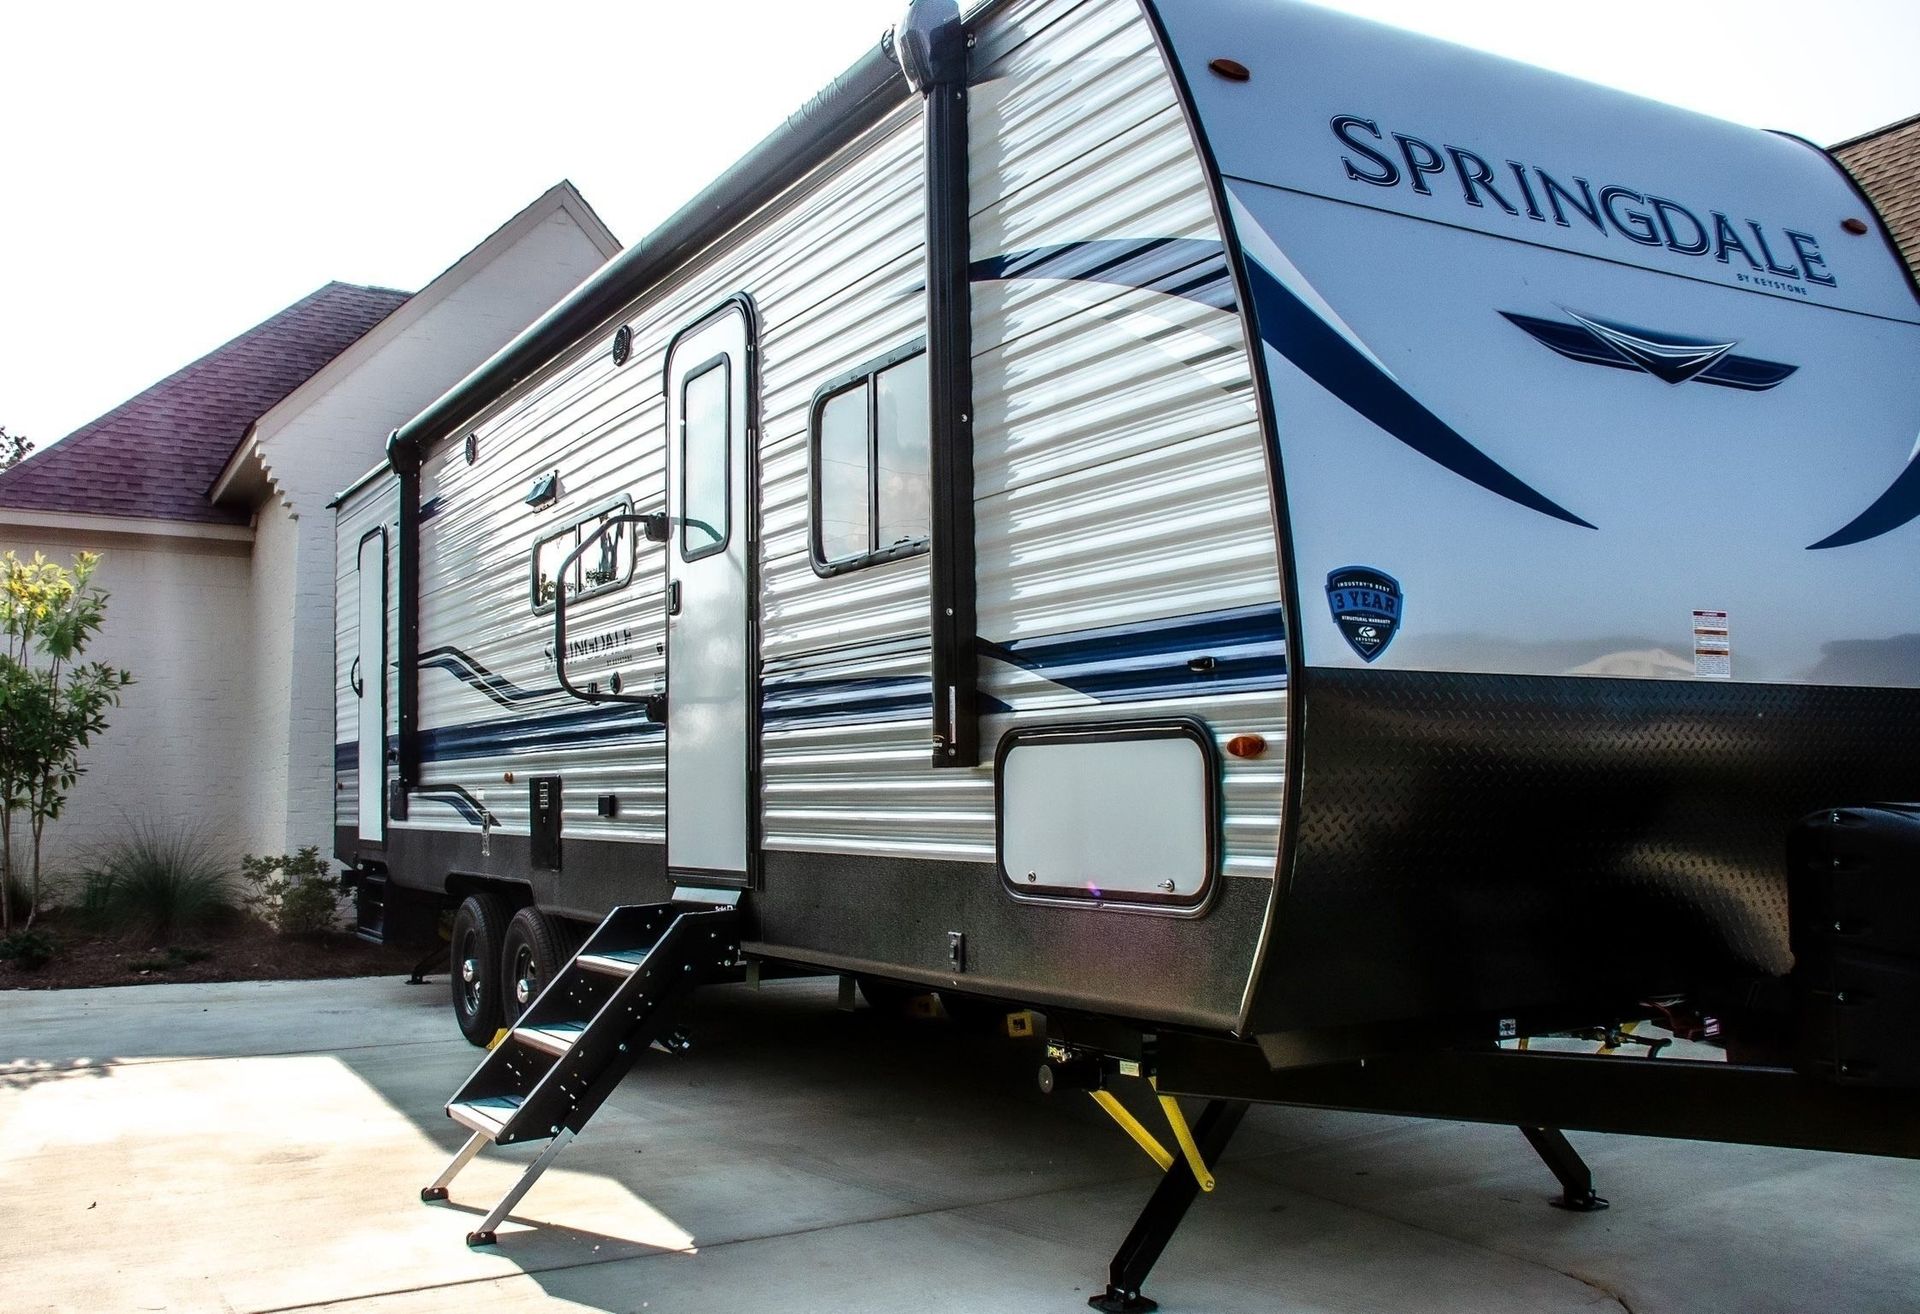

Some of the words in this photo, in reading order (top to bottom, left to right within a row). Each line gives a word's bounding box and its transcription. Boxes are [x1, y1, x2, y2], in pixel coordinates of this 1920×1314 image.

[1329, 114, 1837, 287] SPRINGDALE
[1737, 273, 1749, 283] BY
[1753, 277, 1807, 295] KEYSTONE
[1334, 593, 1345, 610] 3
[1349, 590, 1395, 614] YEAR
[1341, 615, 1368, 623] STRUCTURAL
